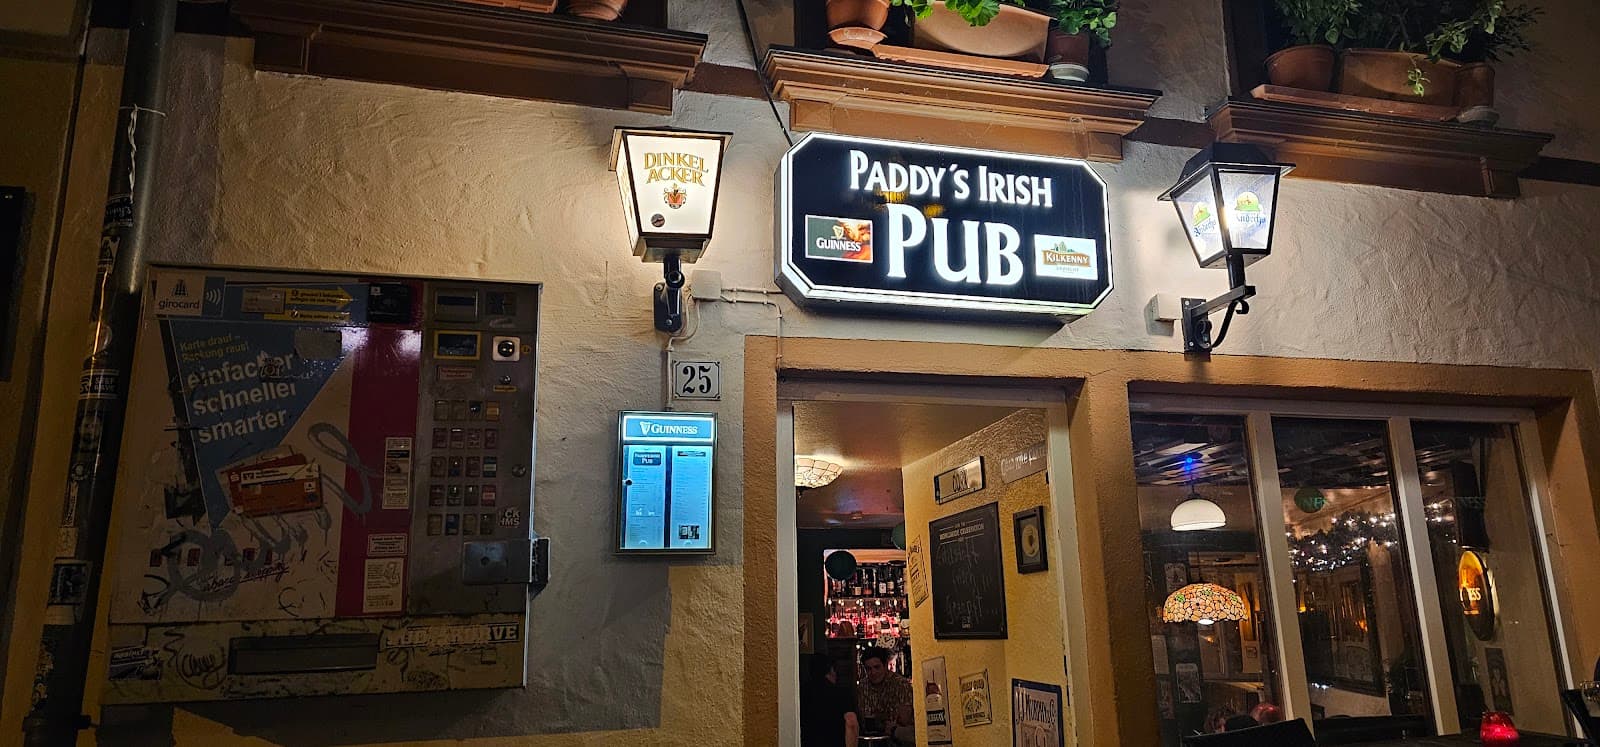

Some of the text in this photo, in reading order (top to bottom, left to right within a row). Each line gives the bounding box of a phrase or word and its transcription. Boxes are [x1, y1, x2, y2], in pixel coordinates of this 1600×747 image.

[643, 152, 709, 173] DINKEL
[645, 166, 705, 187] ACKER
[979, 165, 1052, 208] IRISH
[816, 237, 862, 252] GUINNESS
[886, 203, 1024, 286] PUB
[1046, 252, 1089, 264] KILKENNY
[158, 299, 200, 310] girocard
[182, 349, 224, 363] ackung
[682, 365, 712, 394] 25
[198, 408, 287, 444] smarter
[650, 423, 698, 435] GUINNESS
